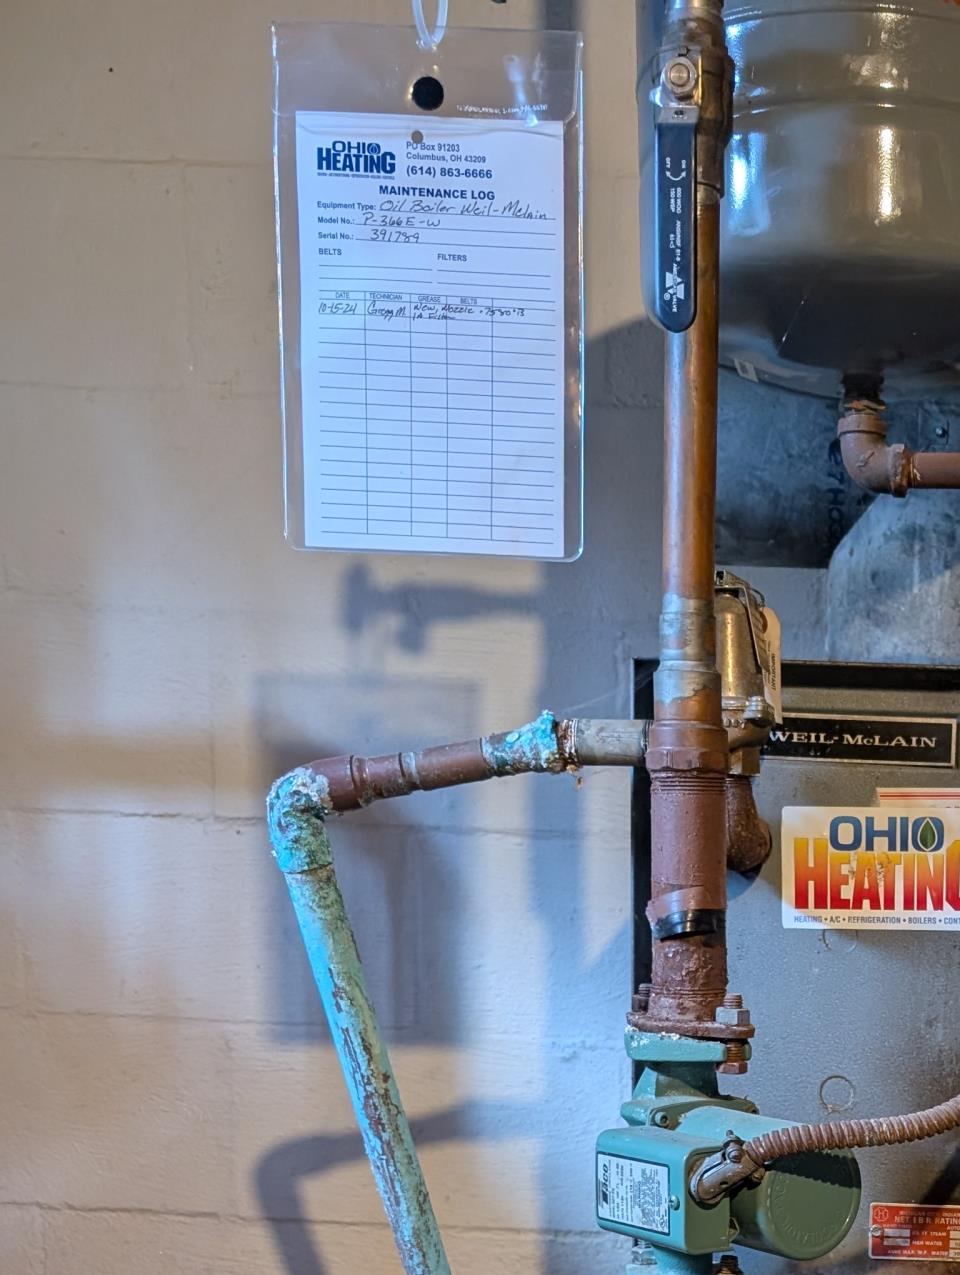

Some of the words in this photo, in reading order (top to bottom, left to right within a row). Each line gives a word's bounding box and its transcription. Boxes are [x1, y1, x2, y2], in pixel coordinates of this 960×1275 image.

[332, 140, 381, 155] OHIO
[420, 142, 435, 151] Box
[437, 143, 460, 152] 91203
[317, 146, 396, 174] HEATING
[406, 152, 449, 163] Columbus,
[450, 154, 462, 163] OH
[464, 155, 486, 164] 43209
[406, 165, 436, 178] (614)
[439, 166, 493, 179] 863-6666
[379, 185, 468, 199] MAINTENANCE
[471, 190, 495, 201] LOG
[317, 201, 355, 212] Equipment
[357, 203, 377, 213] Type:
[379, 199, 405, 213] Oil
[409, 200, 456, 213] Boiler
[317, 216, 341, 225] Model
[318, 231, 338, 240] Serial
[318, 248, 342, 256] BELTS
[437, 253, 467, 262] FILTERS
[369, 292, 403, 301] TECHNICIAN
[318, 302, 358, 315] 10-15-24
[829, 815, 945, 853] OHIO
[794, 915, 823, 924] HEATING
[829, 915, 841, 924] A/C
[847, 916, 901, 924] REFRIGERATION
[908, 916, 936, 925] BOILERS
[894, 1215, 909, 1224] NET
